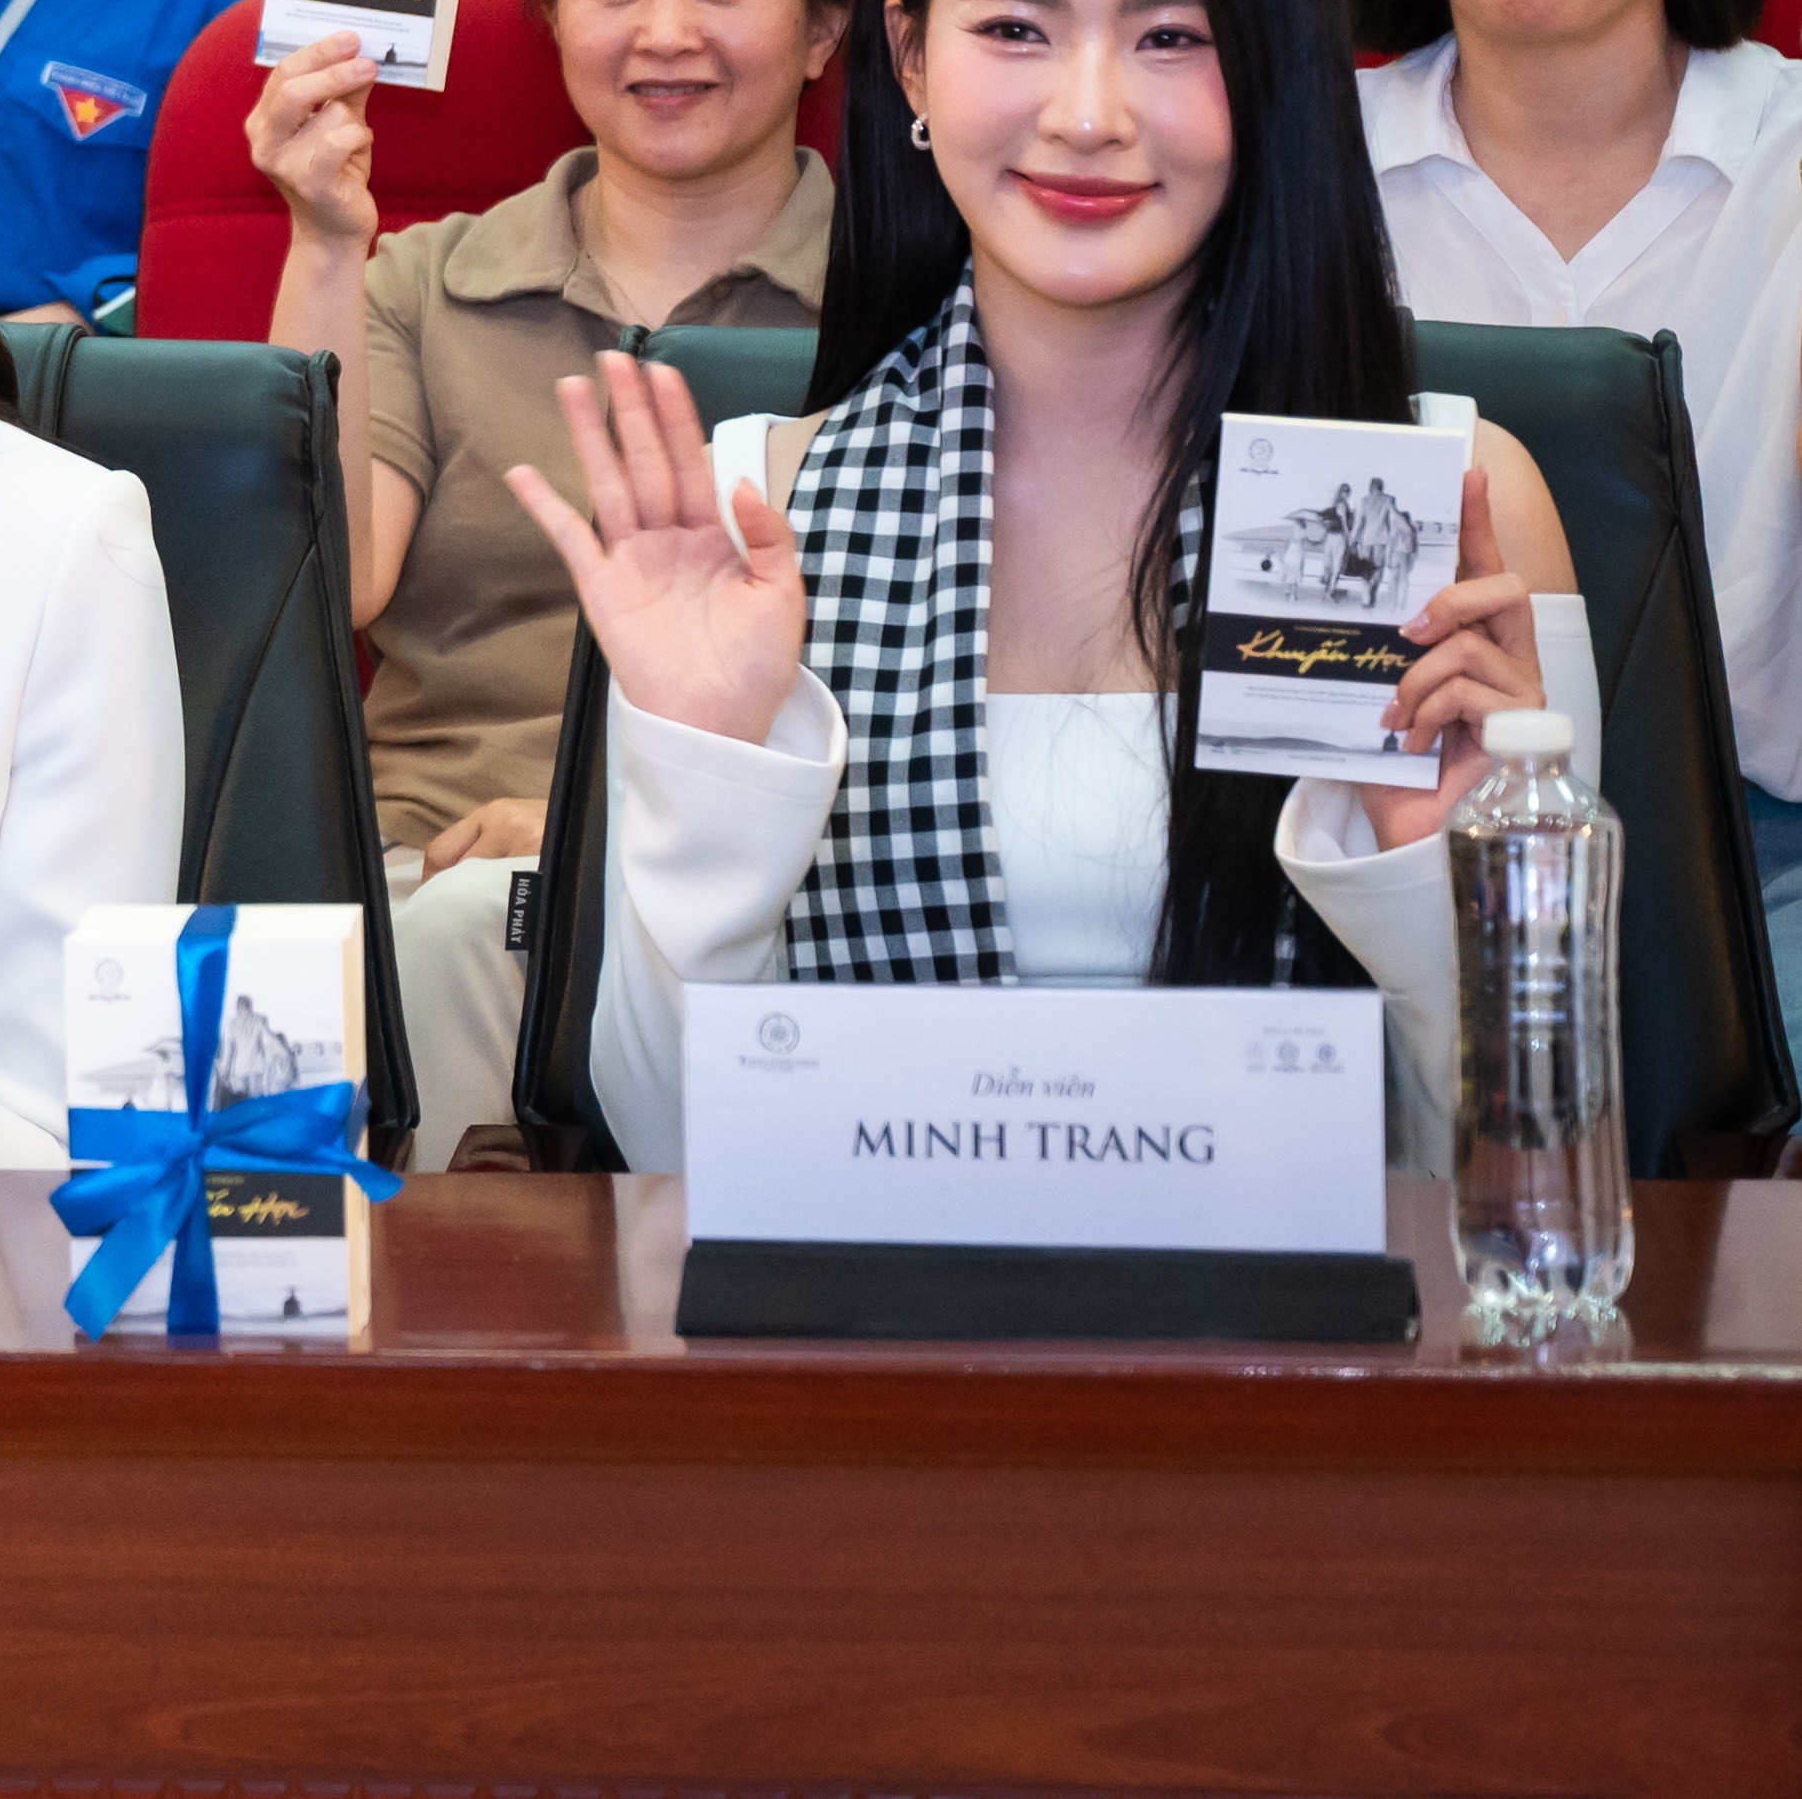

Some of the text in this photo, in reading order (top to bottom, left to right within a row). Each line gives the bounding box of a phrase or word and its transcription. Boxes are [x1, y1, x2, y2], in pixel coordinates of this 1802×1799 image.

[971, 1064, 1096, 1099] Diễn viên
[853, 1122, 1216, 1166] MINH TRANG
